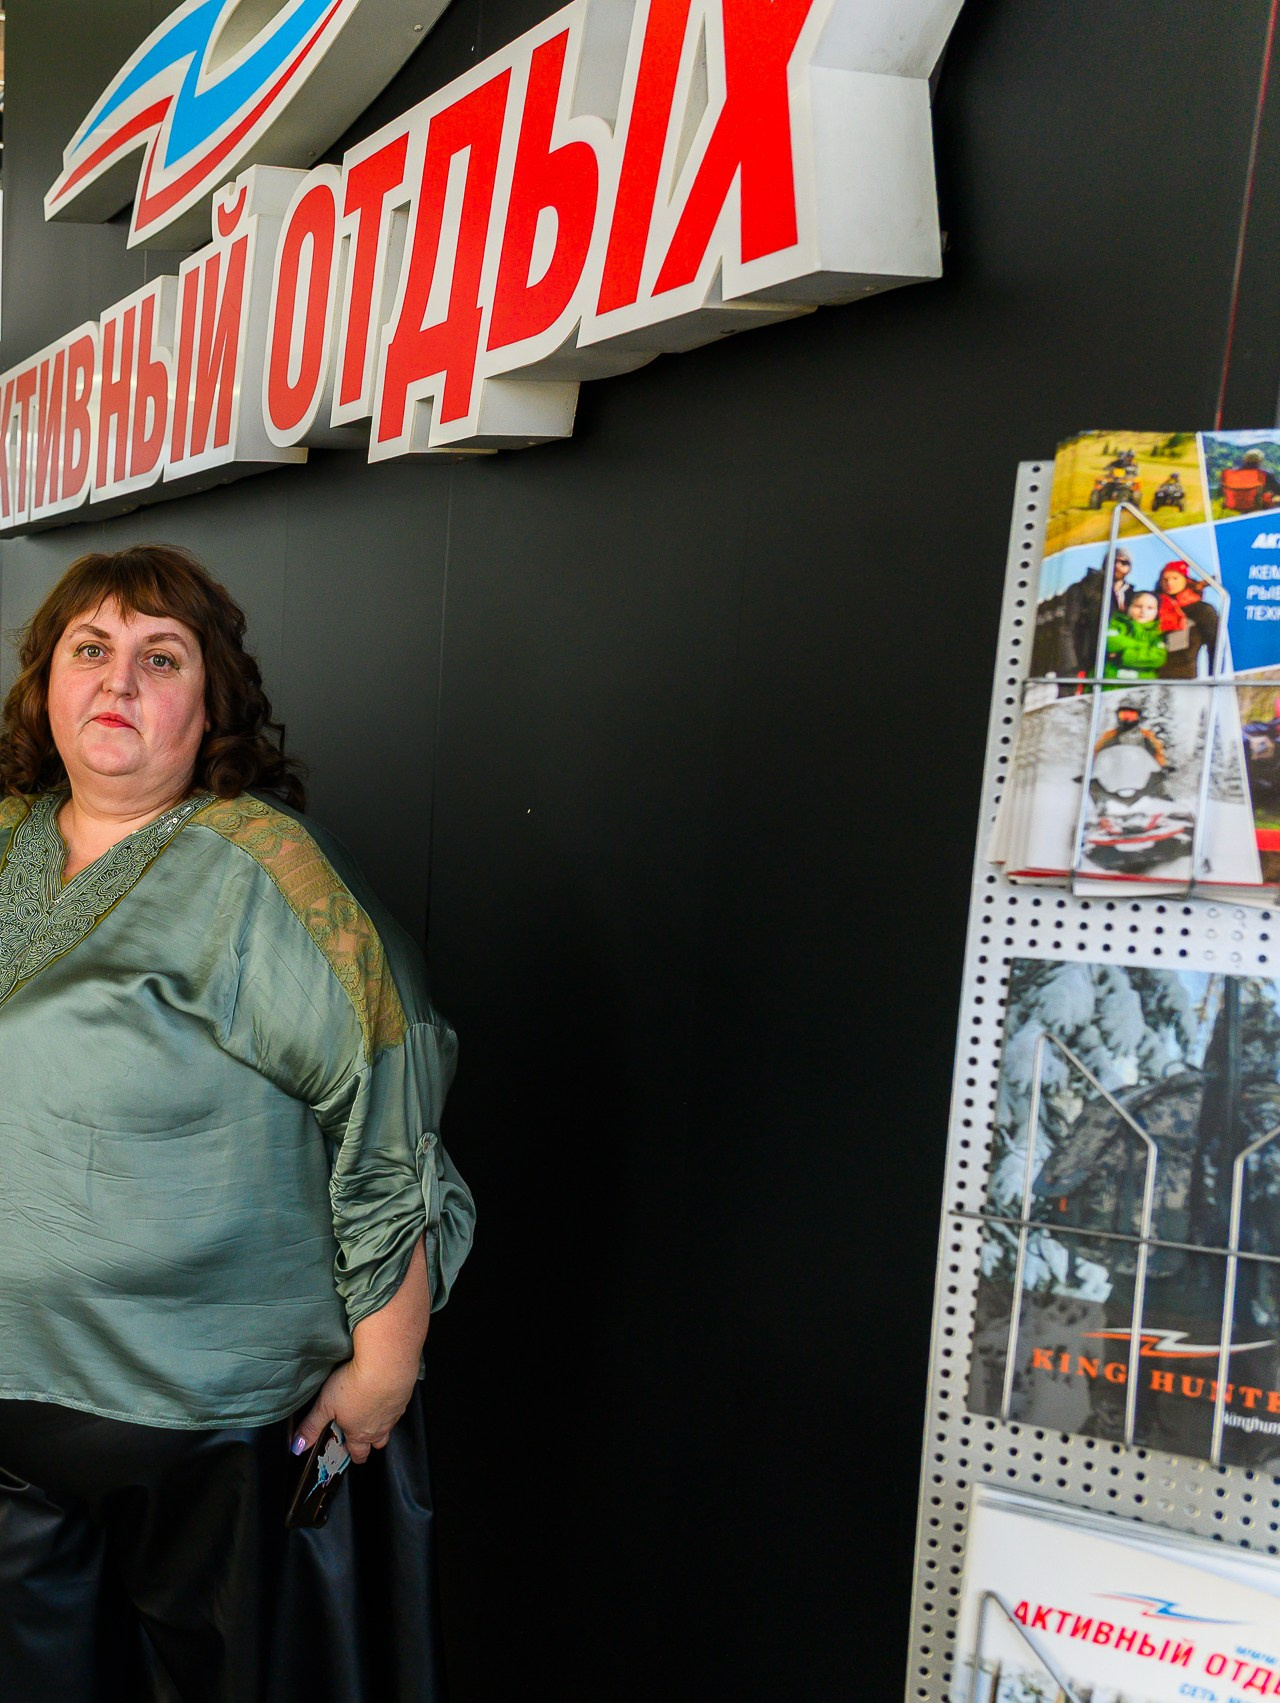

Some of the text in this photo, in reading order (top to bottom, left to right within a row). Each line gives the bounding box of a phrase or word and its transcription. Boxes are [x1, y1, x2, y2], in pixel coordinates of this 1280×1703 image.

[266, 0, 819, 443] ОТДЫХ
[1031, 1346, 1129, 1385] KING
[1008, 1600, 1195, 1668] АКТИВНЫЙ
